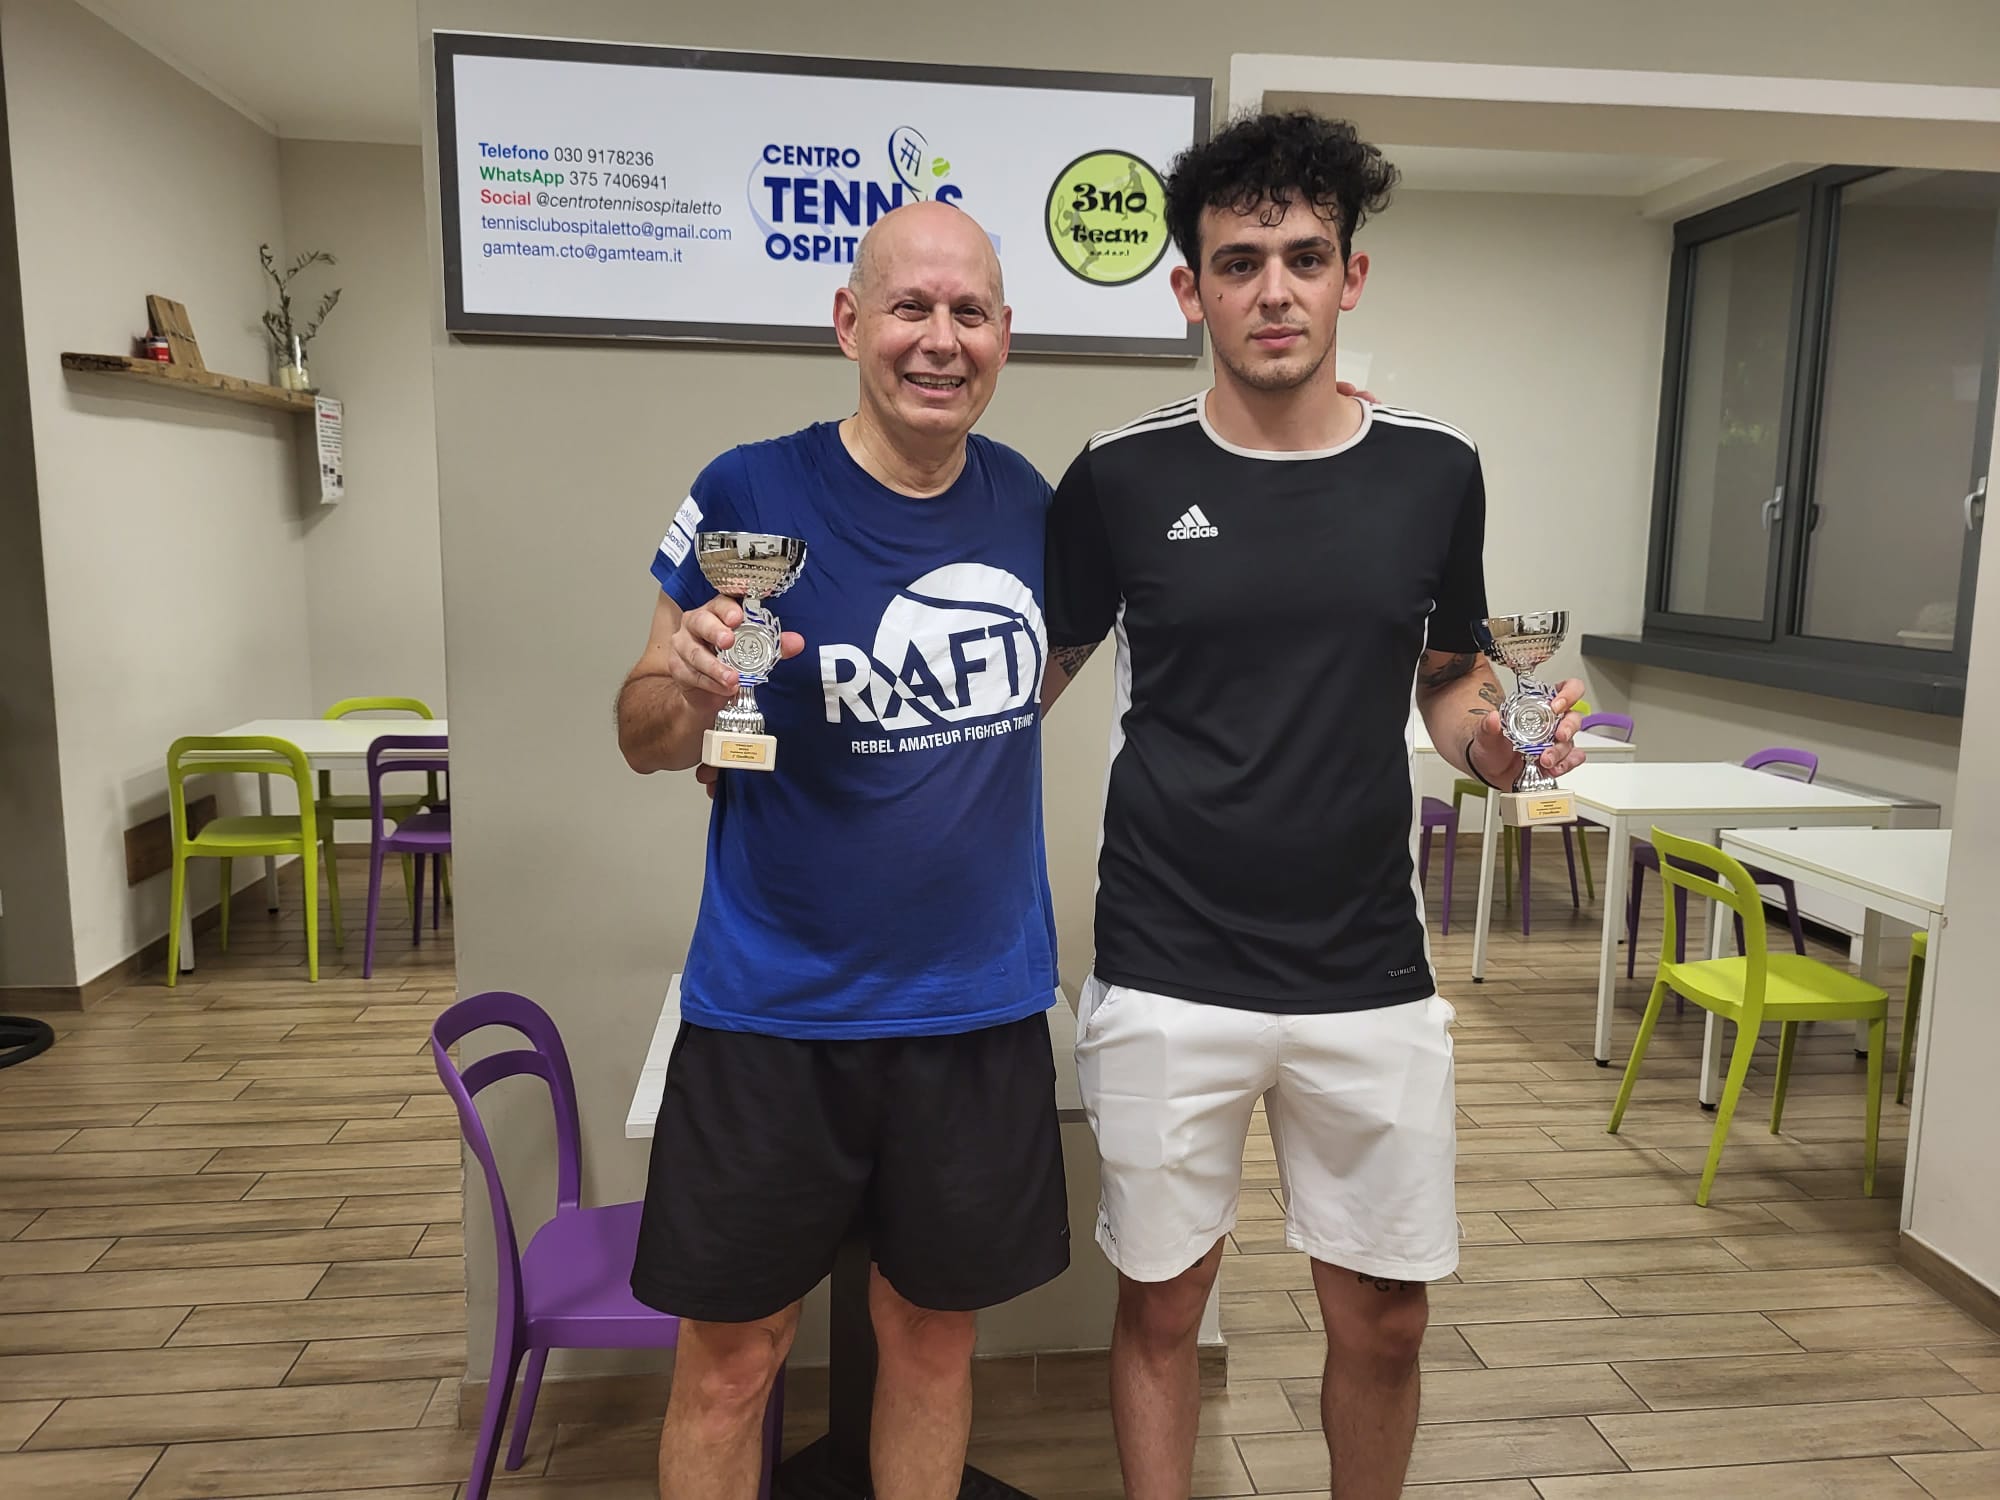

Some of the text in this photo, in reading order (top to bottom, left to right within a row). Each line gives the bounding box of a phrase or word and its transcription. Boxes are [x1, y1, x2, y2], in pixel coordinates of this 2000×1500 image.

[478, 142, 654, 166] Telefono 030 9178236
[763, 144, 860, 168] CENTRO
[480, 166, 667, 190] WhatsApp 375 7406941
[481, 189, 722, 216] Social @centrotennisospitaletto
[1072, 183, 1148, 213] 3no
[481, 215, 732, 240] tennisclubospitaletto@gmail.com
[1070, 224, 1149, 245] team
[482, 241, 682, 263] gamteam.cto@gamteam.it
[765, 232, 860, 263] OSPIT
[1167, 526, 1219, 540] adidas
[851, 740, 895, 754] REBEL
[898, 729, 962, 753] AMATEUR
[964, 716, 1012, 742] FIGHTER
